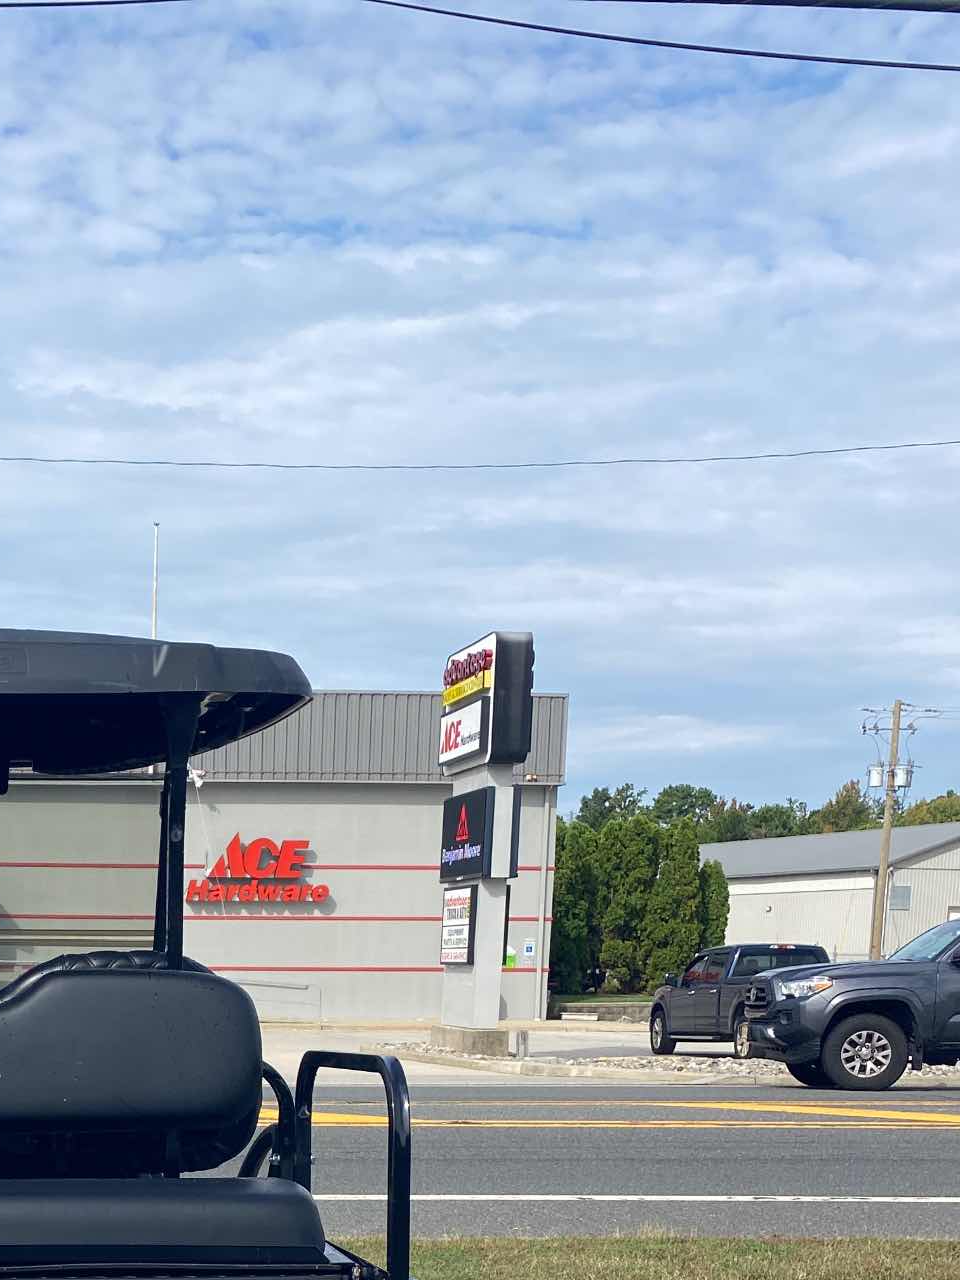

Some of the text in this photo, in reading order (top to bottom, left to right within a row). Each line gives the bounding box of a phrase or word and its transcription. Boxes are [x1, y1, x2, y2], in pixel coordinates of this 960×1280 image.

[441, 720, 462, 754] ACE
[206, 832, 309, 879] ACE
[185, 879, 330, 903] Hardware
